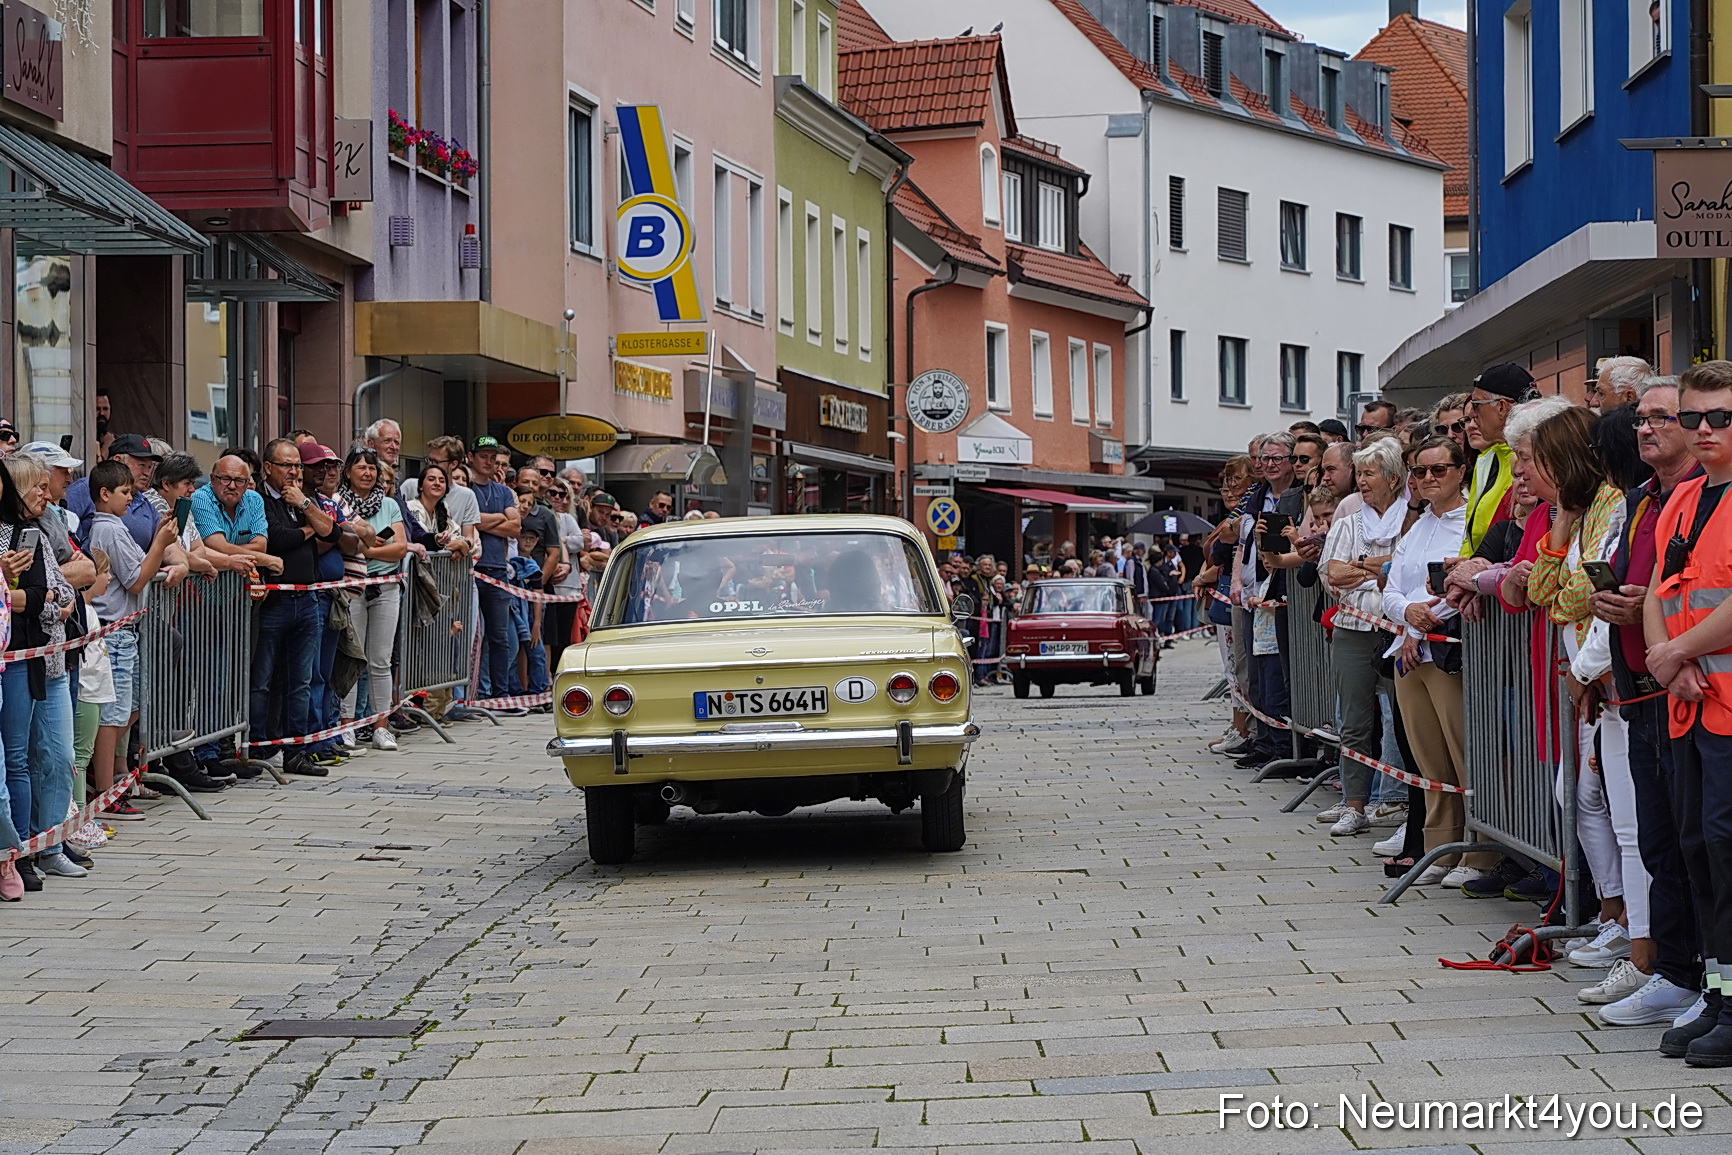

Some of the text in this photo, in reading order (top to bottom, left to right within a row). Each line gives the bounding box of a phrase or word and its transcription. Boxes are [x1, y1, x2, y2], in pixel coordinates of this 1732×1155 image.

[12, 17, 45, 92] Sarah
[625, 216, 666, 258] B
[1666, 230, 1732, 248] OUTL
[621, 338, 701, 349] KLOSTERGASSE 4
[932, 374, 964, 395] FRISEURE
[910, 405, 966, 430] BARBERSHOP
[512, 433, 615, 442] DIE GOLDSCHMIEDE
[956, 469, 987, 477] Klostergasse
[915, 487, 947, 496] Glasergasse
[709, 601, 764, 613] OPEL
[848, 681, 863, 700] D
[698, 690, 826, 715] D N TS 664H
